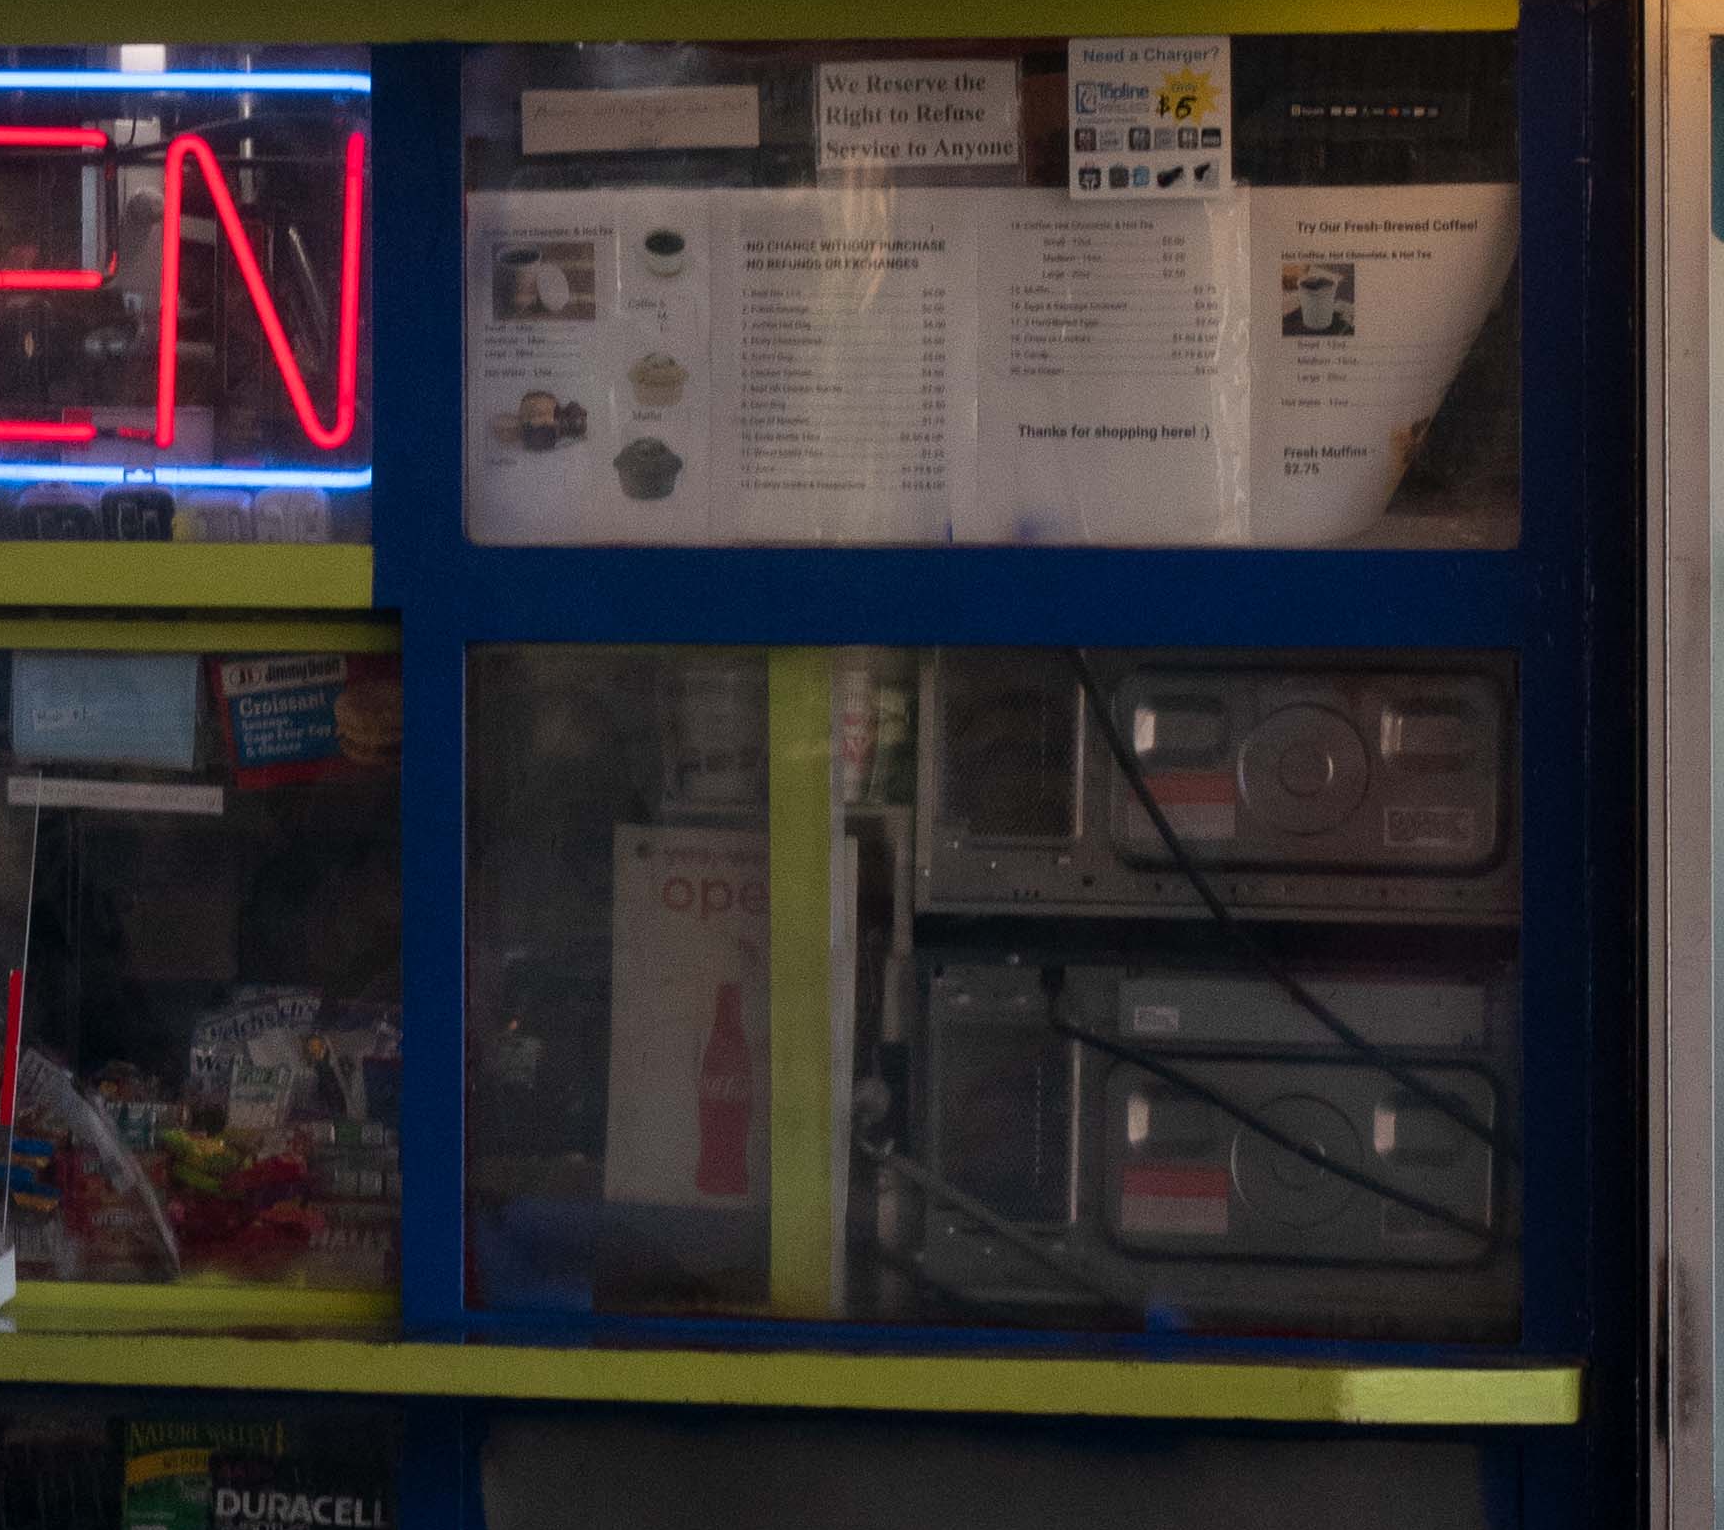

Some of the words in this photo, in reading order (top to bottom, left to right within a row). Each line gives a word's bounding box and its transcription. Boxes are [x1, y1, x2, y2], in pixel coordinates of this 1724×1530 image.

[1082, 49, 1124, 64] Need
[1129, 51, 1138, 61] a
[1143, 46, 1219, 64] Charger?
[826, 76, 859, 94] We
[866, 74, 946, 93] Reserve
[953, 73, 986, 92] the
[826, 105, 883, 128] Right
[889, 107, 909, 124] to
[916, 104, 985, 123] Refuse
[826, 140, 900, 159] Service
[908, 140, 926, 158] to
[933, 138, 1013, 163] Anyone
[1297, 220, 1316, 234] Try
[1319, 221, 1340, 233] Our
[1344, 220, 1429, 232] Fresh-Brewed
[1432, 220, 1478, 232] Coffee!
[746, 240, 763, 253] NO
[767, 239, 817, 252] CHANGE
[1019, 424, 1067, 438] Thanks
[1071, 424, 1090, 438] for
[1095, 424, 1158, 441] shopping
[1161, 424, 1196, 438] here!
[1283, 445, 1319, 459] Fresh
[1322, 444, 1368, 458] Muffins
[1283, 462, 1320, 476] $2.75
[239, 691, 326, 717] Croissant
[662, 877, 770, 921] ope
[214, 1487, 391, 1528] DURACELL
